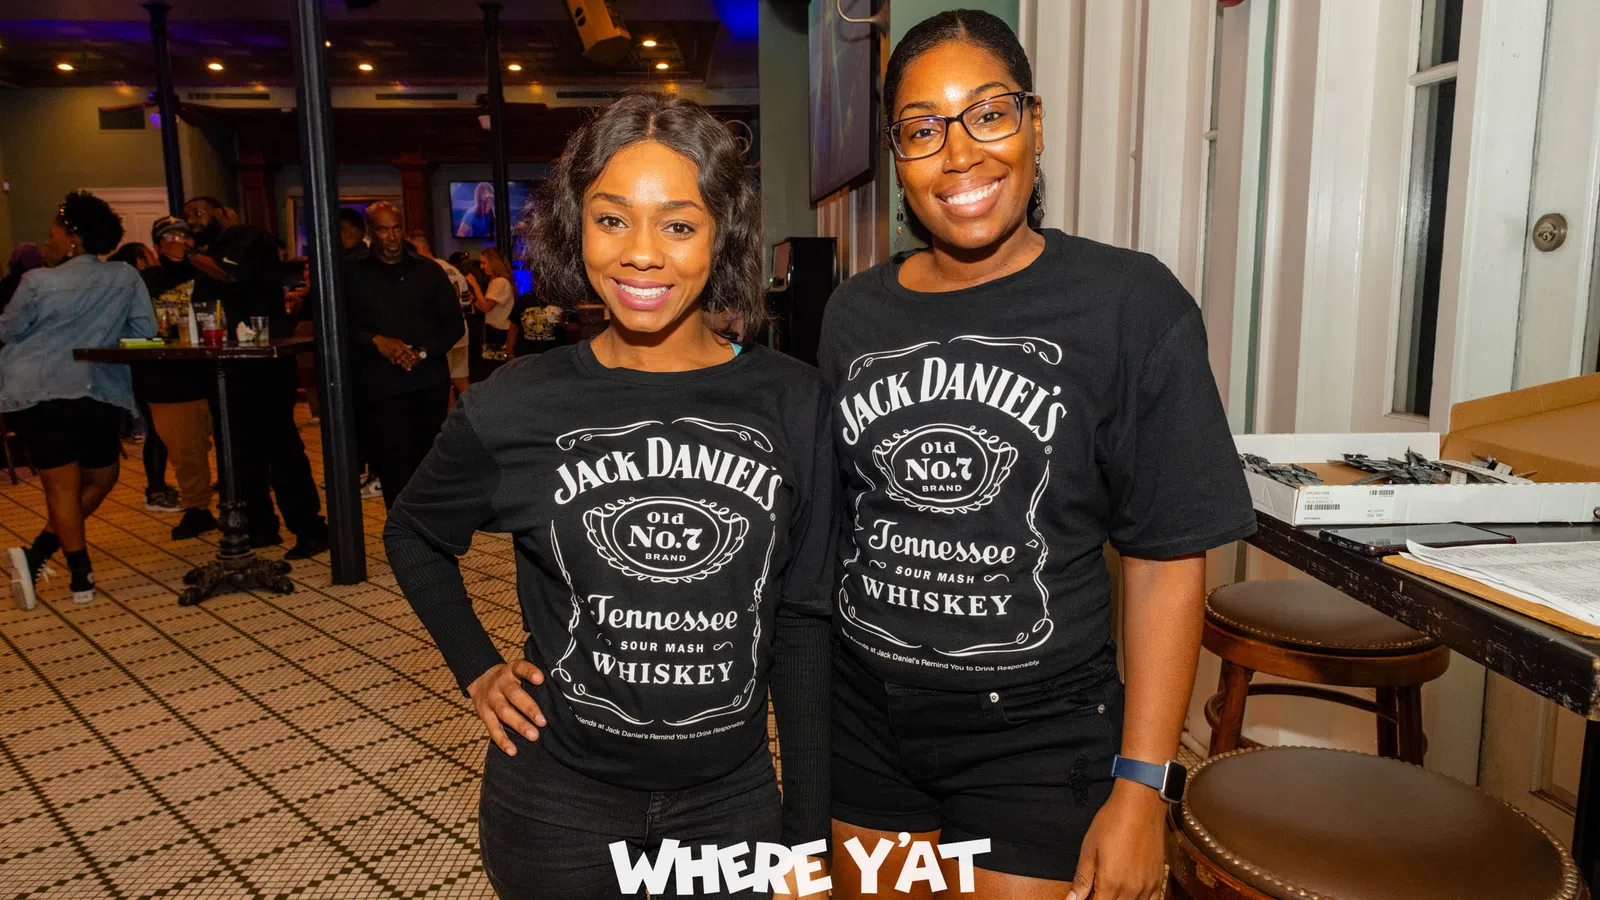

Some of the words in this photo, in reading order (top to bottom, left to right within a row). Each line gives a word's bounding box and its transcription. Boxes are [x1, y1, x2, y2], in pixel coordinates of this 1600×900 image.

[840, 370, 915, 445] JACK
[919, 357, 1067, 442] DANIEL'S
[920, 441, 956, 454] Old
[554, 451, 644, 505] JACK
[646, 436, 782, 511] DANIEL'S
[905, 457, 973, 481] No.7
[647, 511, 684, 525] Old
[627, 525, 702, 550] No.7
[868, 519, 1016, 565] Tennessee
[645, 553, 687, 562] BRAND
[895, 565, 931, 580] SOUR
[937, 572, 975, 584] MASH
[861, 574, 1012, 617] WHISKEY
[588, 594, 738, 632] Tennessee
[620, 640, 658, 652] SOUR
[665, 643, 704, 653] MASH
[870, 646, 876, 654] at
[876, 649, 891, 659] Jack
[892, 653, 920, 665] Daniel's
[921, 658, 949, 669] Remind
[950, 663, 964, 671] You
[592, 651, 734, 685] WHISKEY
[575, 713, 597, 727] riends
[597, 722, 605, 730] at
[605, 726, 620, 735] Jack
[621, 730, 649, 739] Daniel's
[696, 730, 712, 738] Drink
